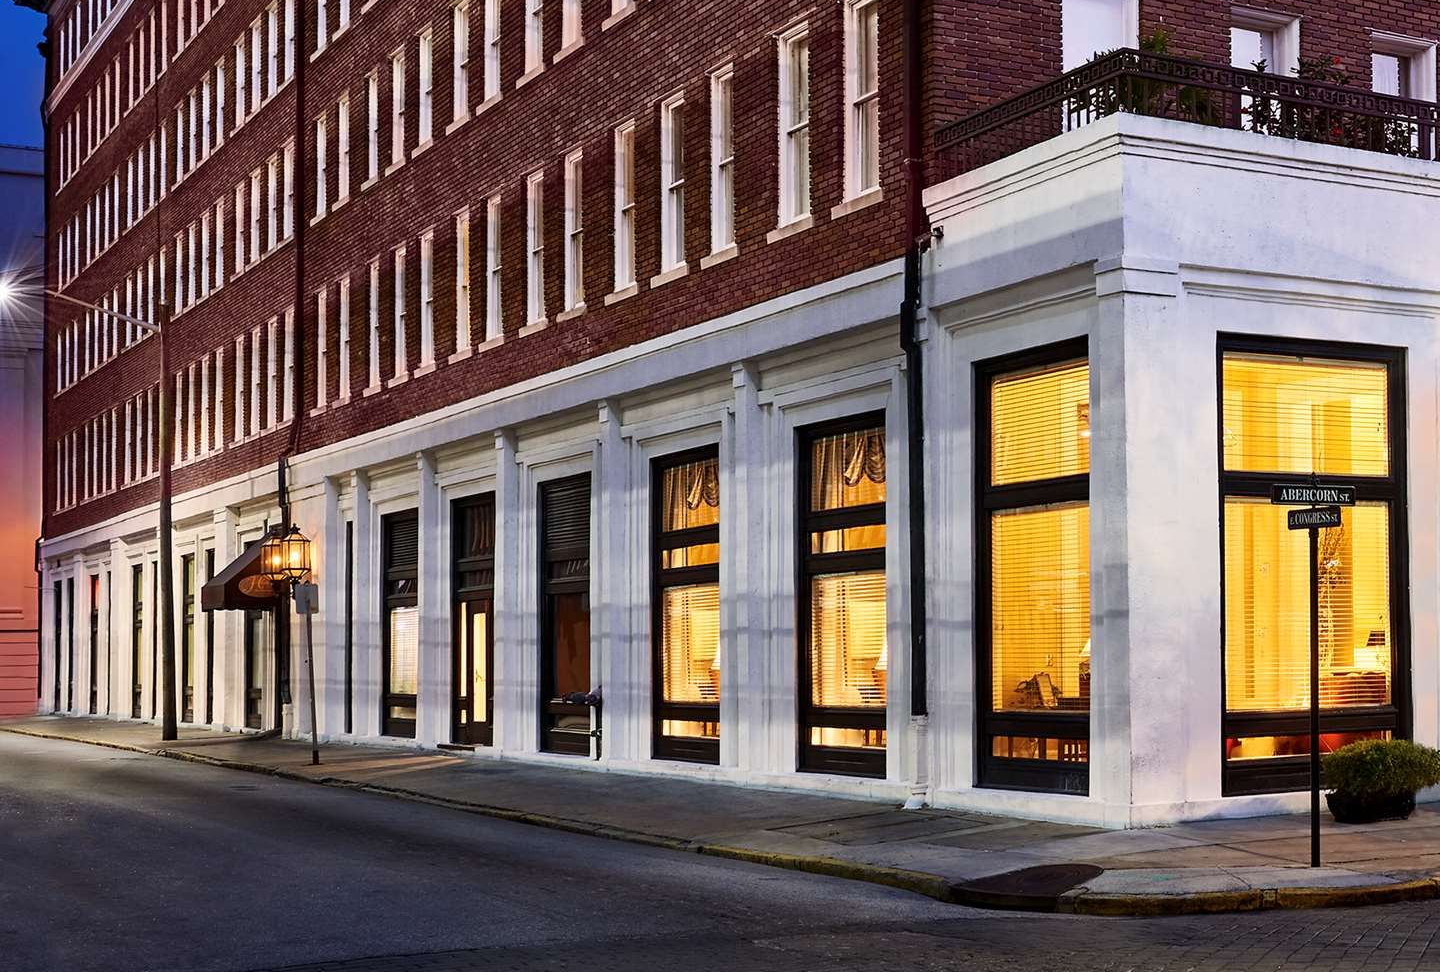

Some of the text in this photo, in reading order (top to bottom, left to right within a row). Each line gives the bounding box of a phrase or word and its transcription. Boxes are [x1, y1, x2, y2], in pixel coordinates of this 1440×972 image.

[1280, 488, 1350, 502] ABERCORN ST.
[1294, 511, 1330, 524] CONGRESS
